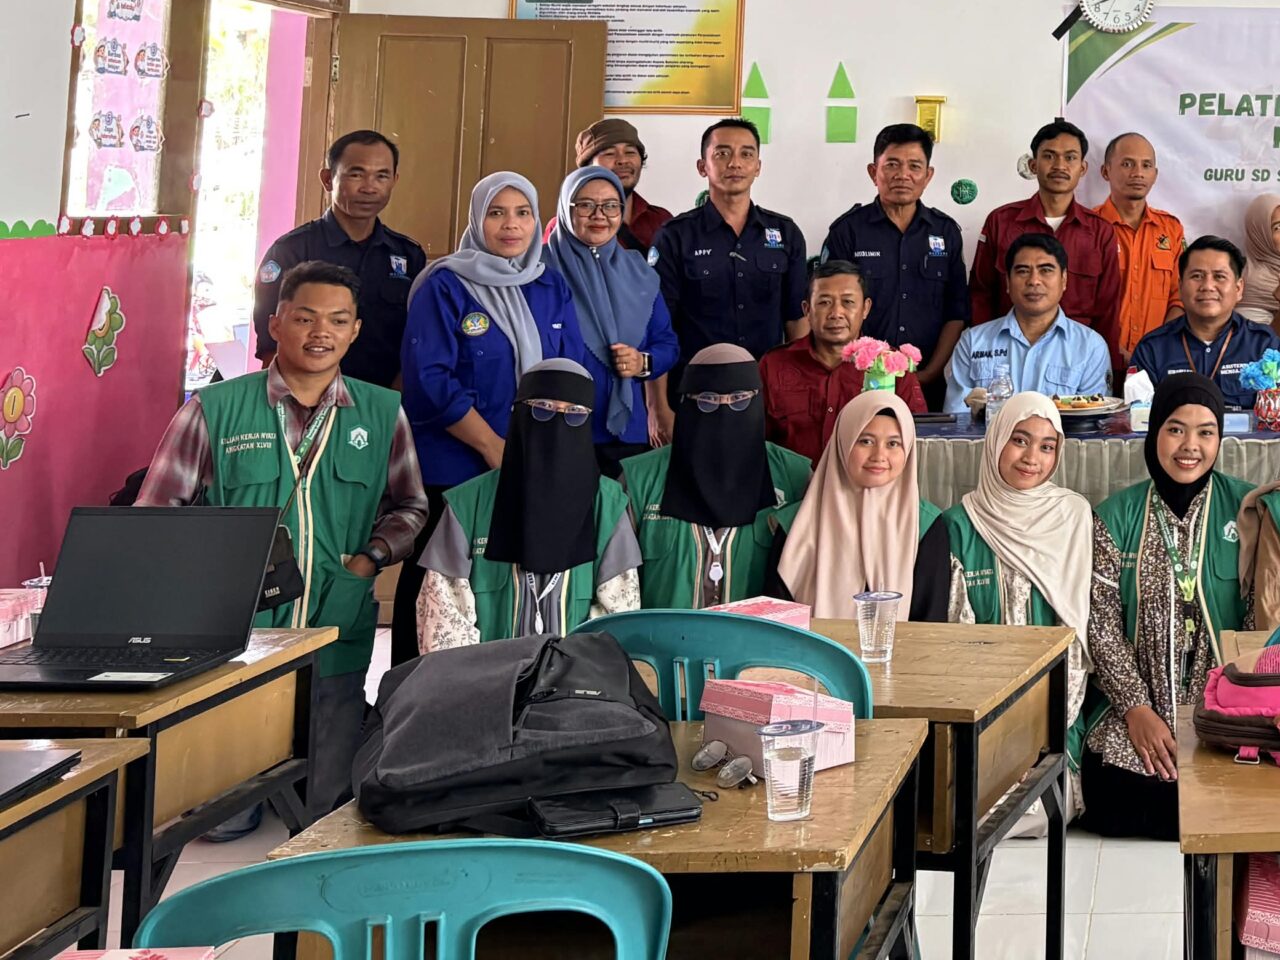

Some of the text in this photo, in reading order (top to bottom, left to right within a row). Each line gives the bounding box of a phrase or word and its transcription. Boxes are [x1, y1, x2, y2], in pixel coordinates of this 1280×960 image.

[1133, 3, 1140, 12] 4
[1113, 14, 1120, 24] 6
[1203, 168, 1245, 181] GURU
[1251, 168, 1271, 182] SD
